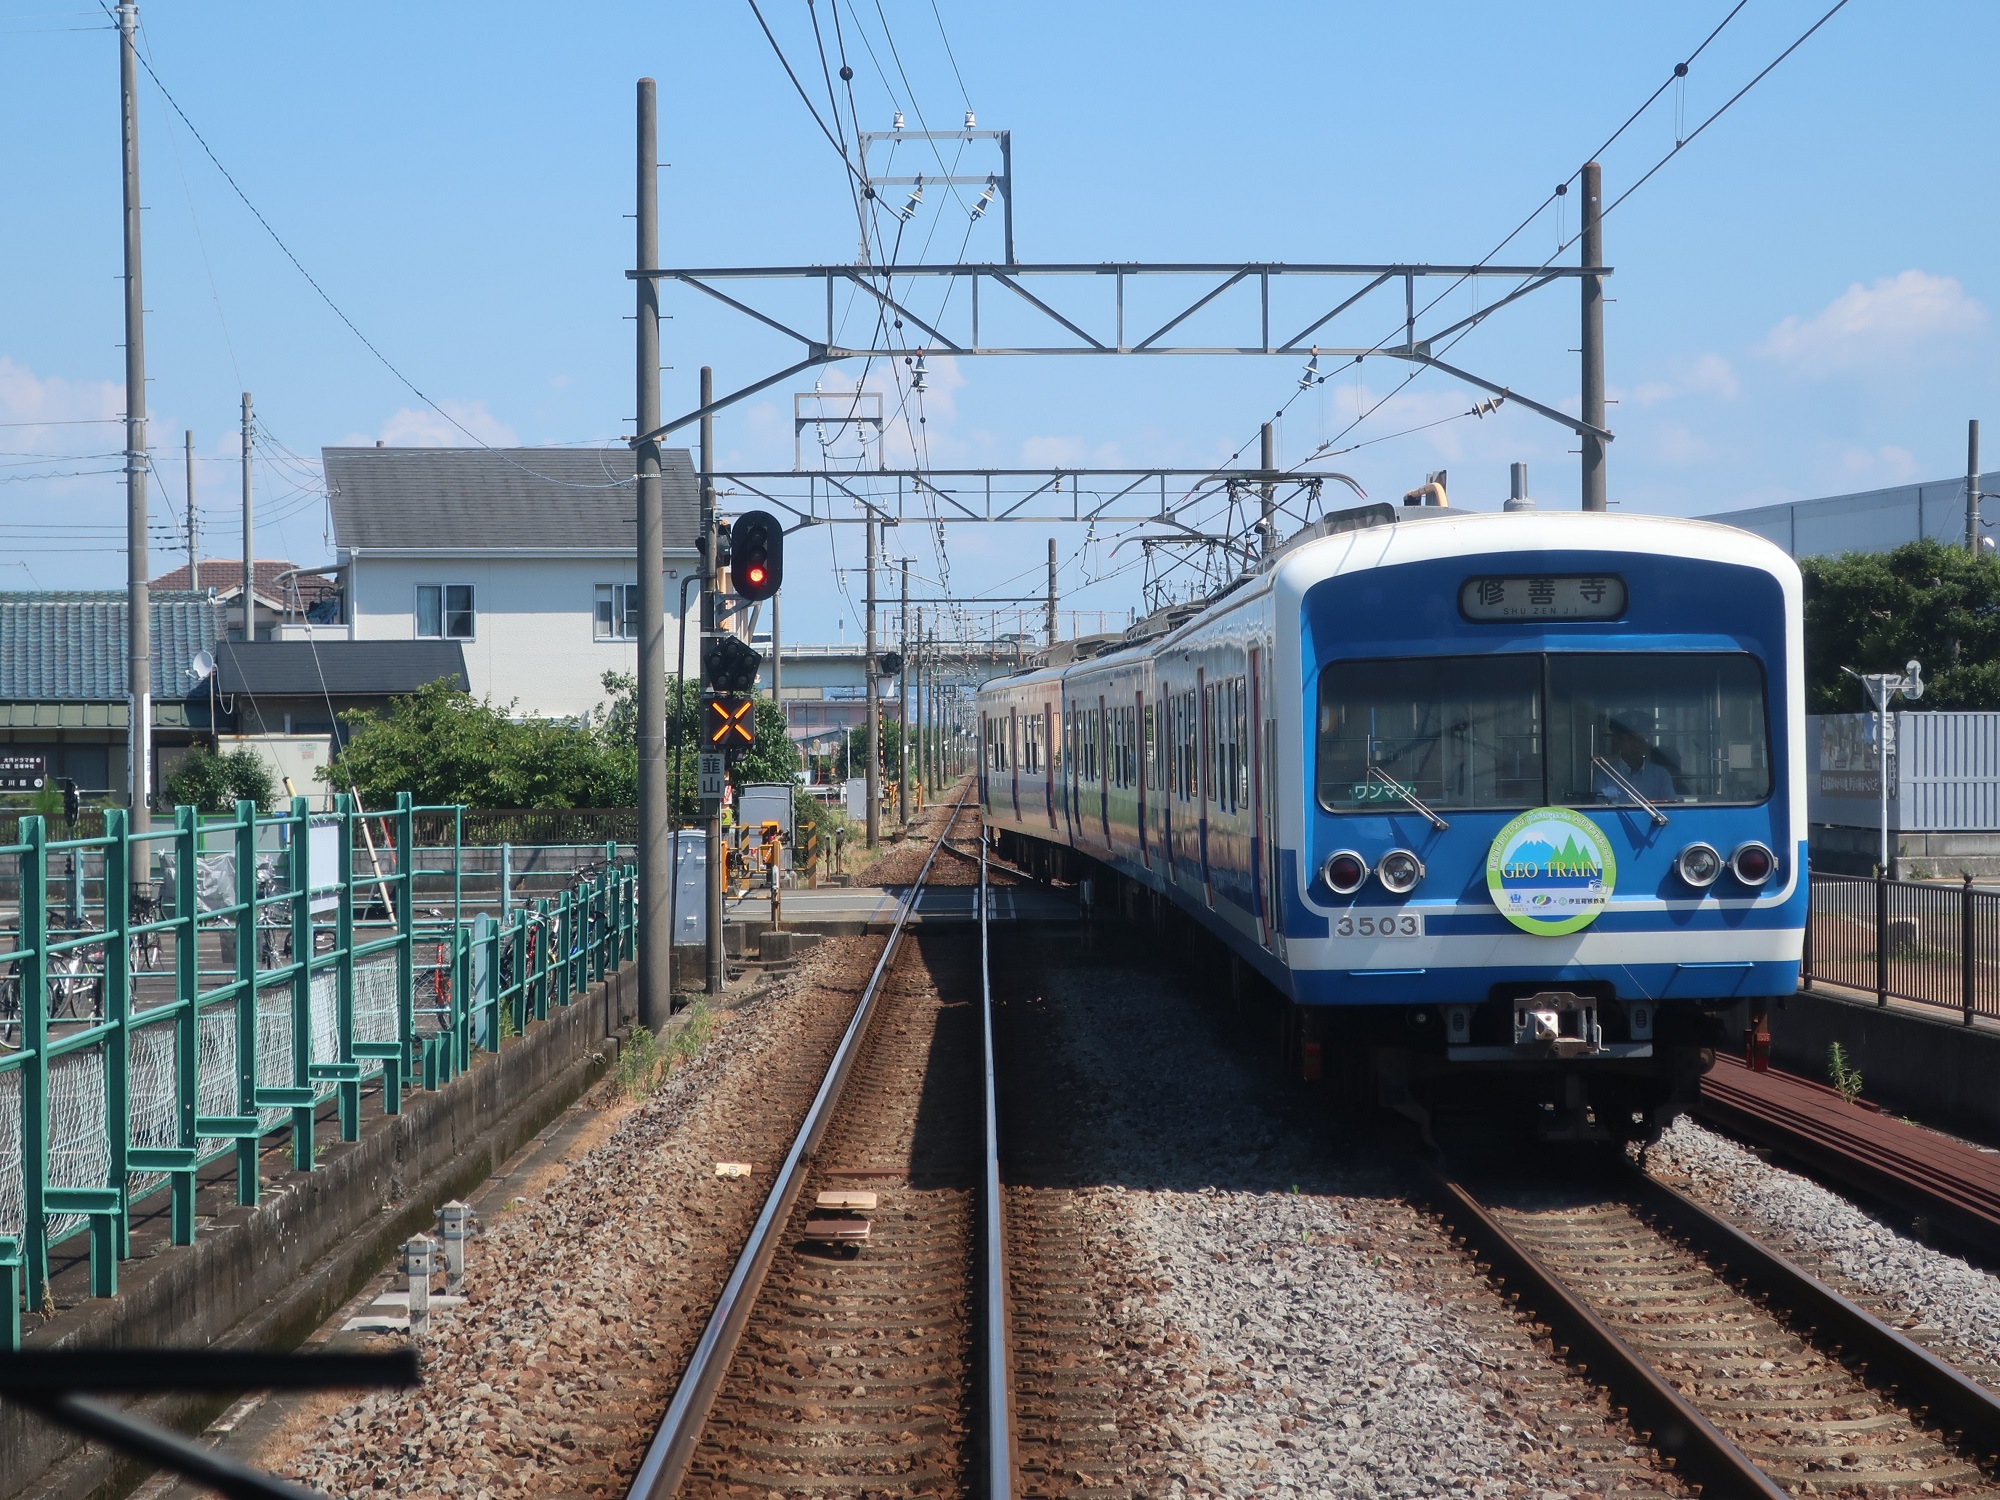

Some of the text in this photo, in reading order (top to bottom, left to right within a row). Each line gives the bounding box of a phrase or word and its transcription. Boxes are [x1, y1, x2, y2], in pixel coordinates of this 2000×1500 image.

[1477, 578, 1607, 606] 修善寺
[702, 758, 720, 793] 韮山
[1355, 785, 1412, 799] ワンマン
[1502, 860, 1600, 878] GEO TRAIN
[1337, 916, 1417, 936] 3503
